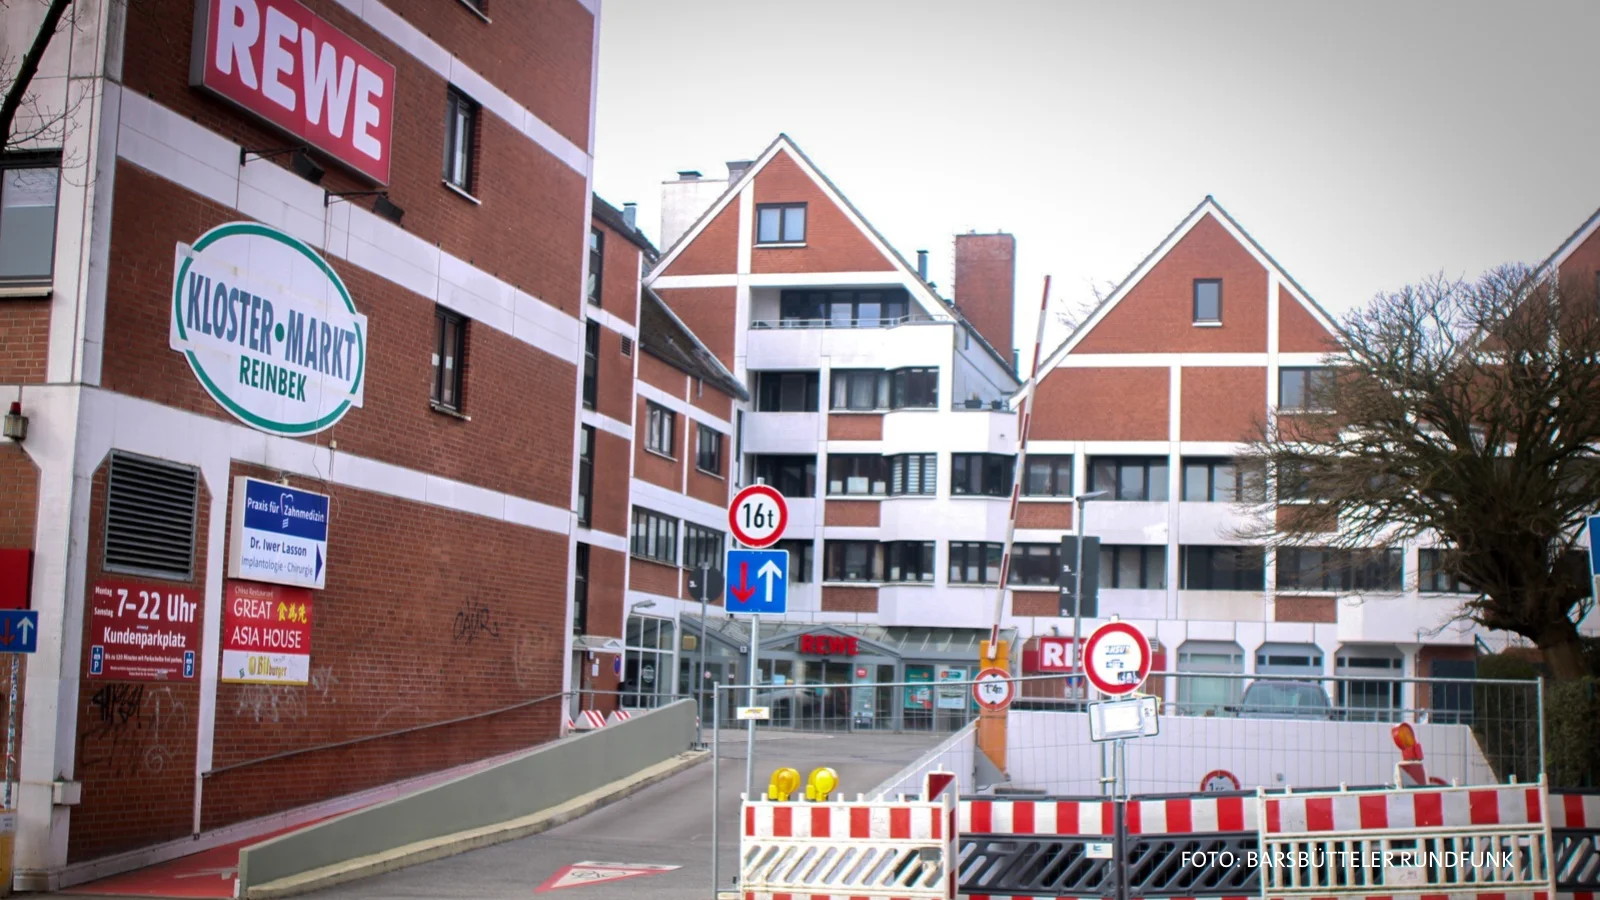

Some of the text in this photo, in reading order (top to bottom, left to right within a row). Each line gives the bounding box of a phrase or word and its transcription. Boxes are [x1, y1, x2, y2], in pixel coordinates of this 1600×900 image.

[216, 0, 384, 161] REWE
[239, 354, 307, 402] REINBEK
[247, 496, 324, 523] Praxis für Zahnmedizin
[250, 536, 307, 557] Dr. Iwer Lasson
[242, 555, 313, 578] Implantologie Chirurgie
[95, 586, 113, 598] Montag
[94, 606, 114, 619] Samstag
[167, 593, 197, 623] Uhr
[233, 598, 273, 620] GREAT
[103, 626, 186, 650] Kundenparkplatz
[231, 625, 302, 649] ASIA HOUSE
[800, 633, 859, 656] REWE
[256, 655, 287, 678] Bitburger
